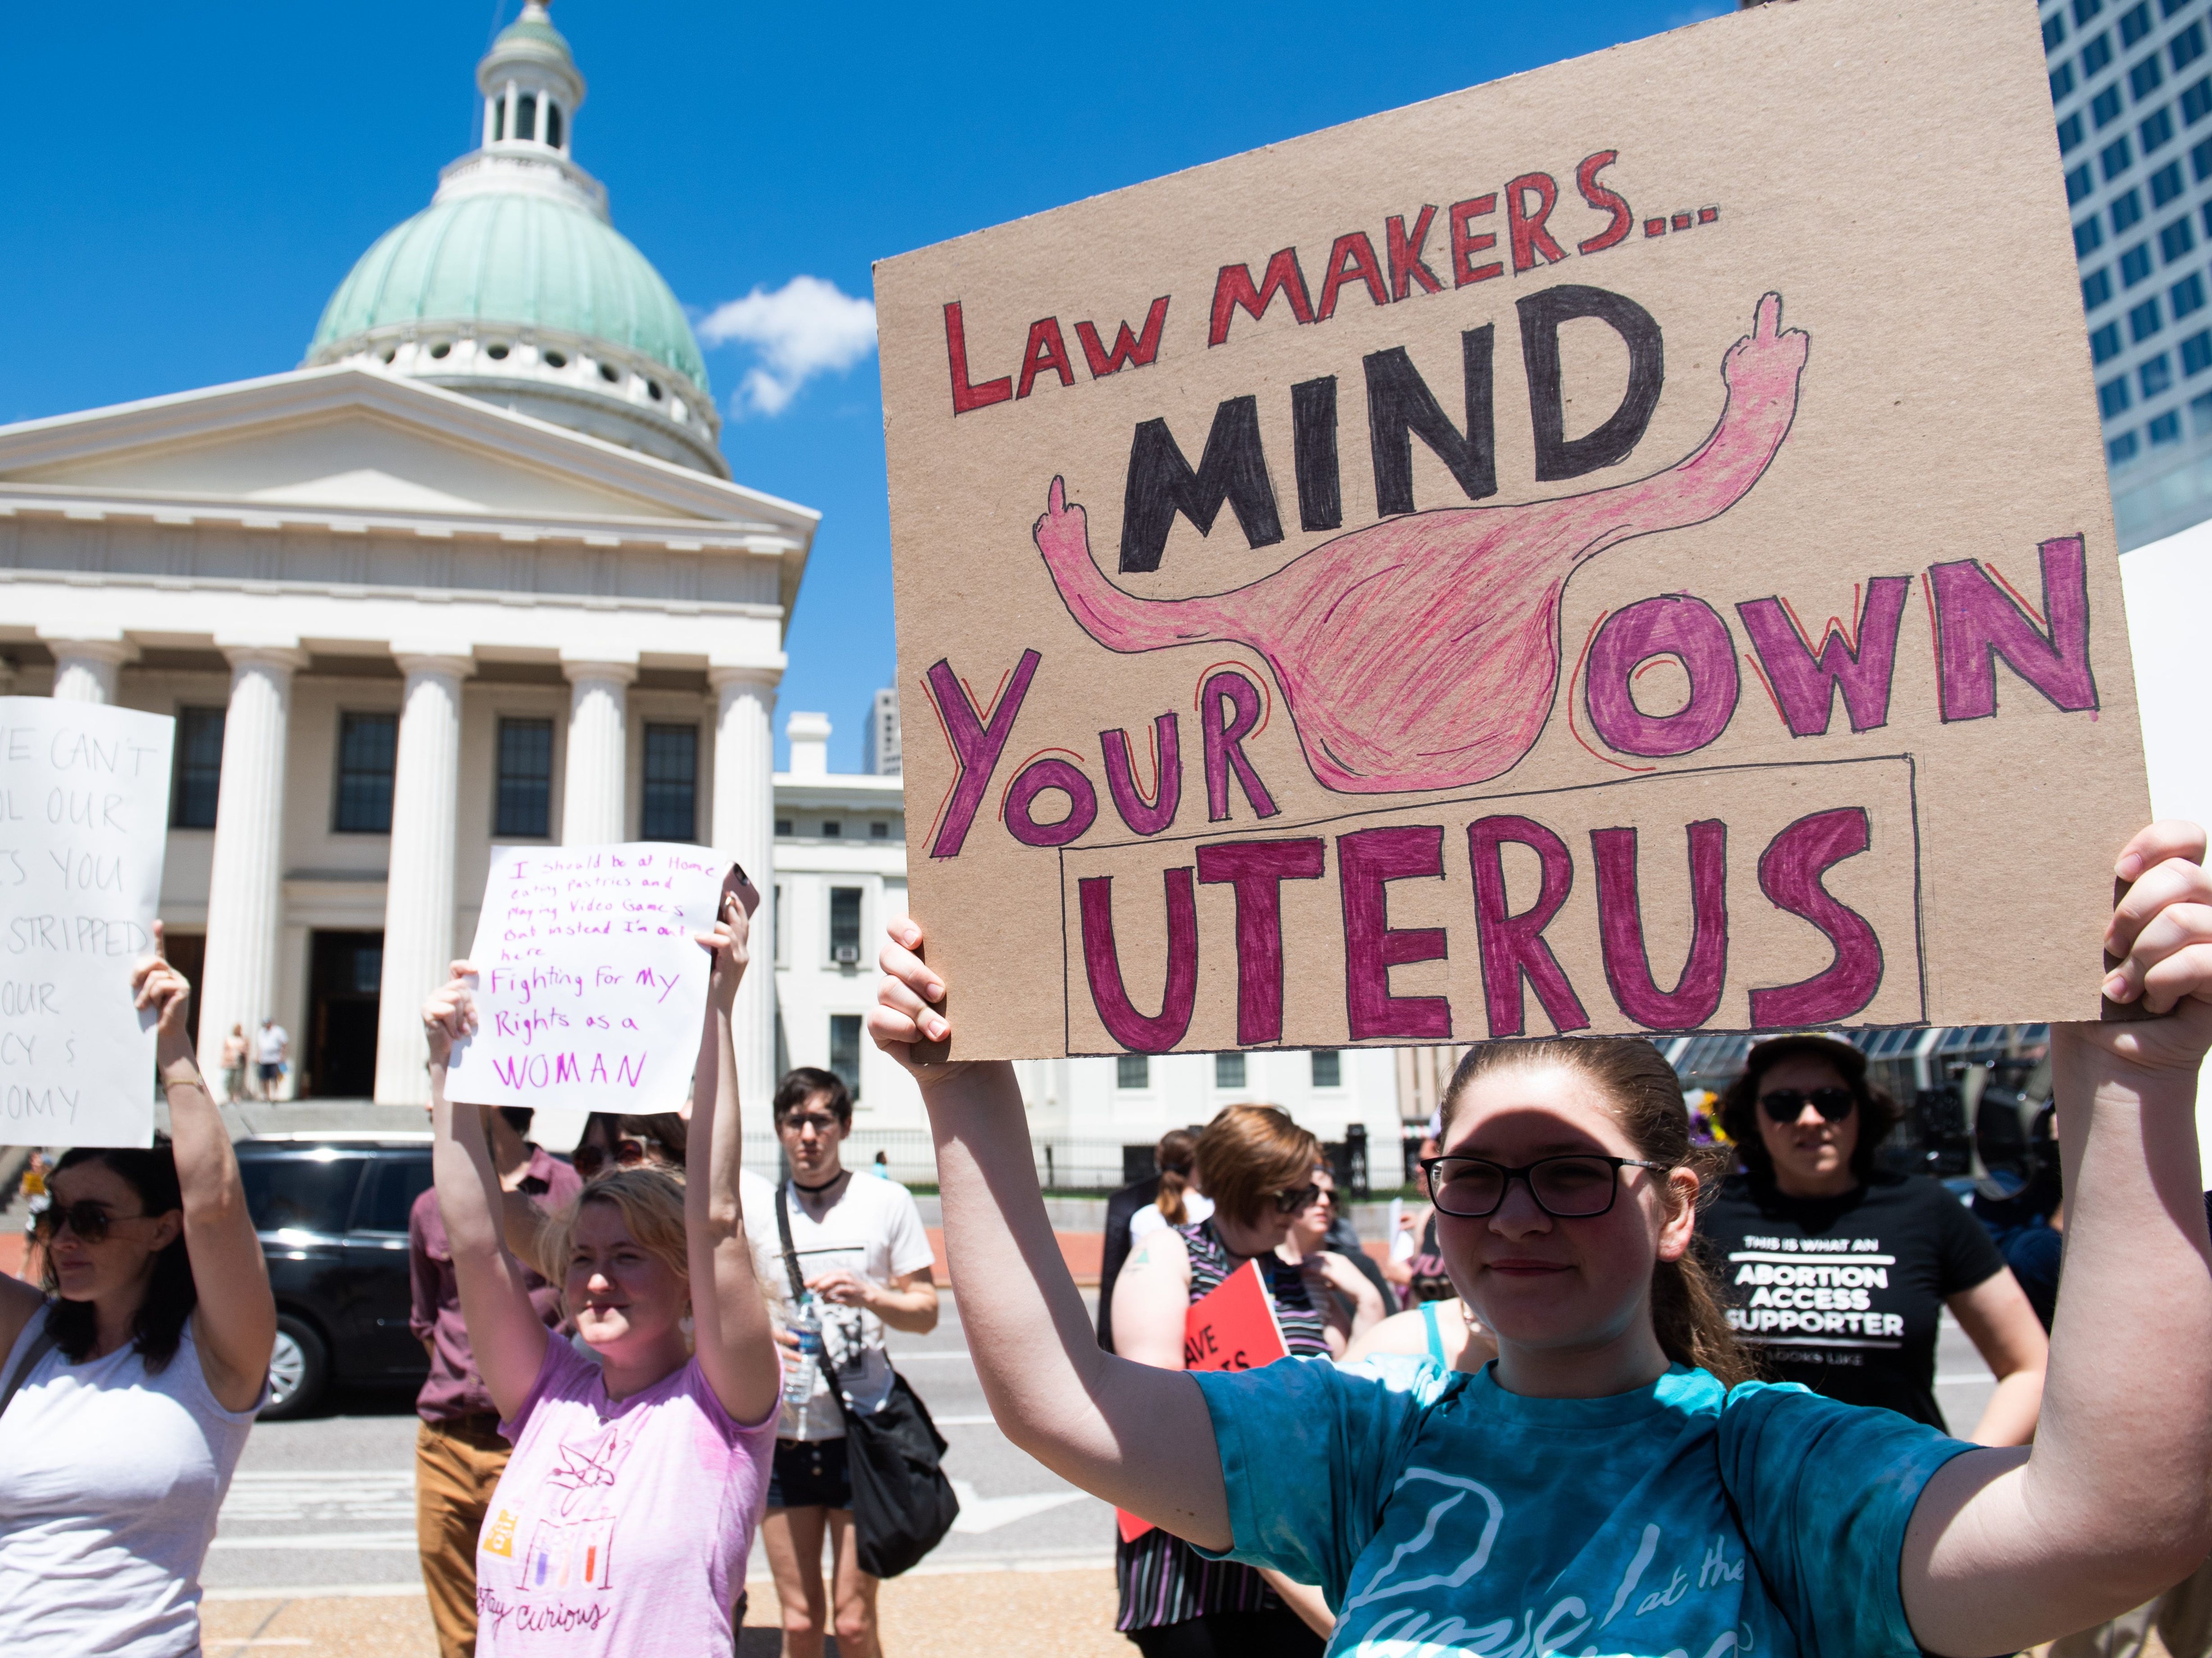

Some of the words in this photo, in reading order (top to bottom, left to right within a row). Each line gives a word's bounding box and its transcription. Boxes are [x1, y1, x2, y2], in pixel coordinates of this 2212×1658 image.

[944, 295, 1170, 417] LAW
[1119, 284, 1664, 575] MIND
[927, 648, 1281, 859] YOUR
[1584, 532, 2100, 758] OWN
[51, 727, 157, 776] CAN'T
[47, 787, 126, 833] OUR
[49, 847, 122, 891] YOU
[510, 861, 528, 879] I
[612, 854, 625, 867] be
[638, 854, 653, 867] at
[642, 877, 672, 890] and
[8, 914, 148, 956] STRIPPED
[549, 921, 610, 936] instead
[624, 919, 647, 932] I'm
[1079, 806, 1884, 1054] UTERUS
[501, 948, 545, 961] here
[492, 966, 583, 1004] Fighting
[496, 1007, 569, 1045] Rights
[587, 1015, 610, 1030] as
[622, 1018, 639, 1031] a
[493, 1051, 647, 1090] WOMAN
[1743, 1236, 1780, 1250] THIS
[1782, 1238, 1798, 1251] IS
[1799, 1239, 1850, 1252] WHAT
[1851, 1239, 1879, 1251] AN
[1734, 1264, 1888, 1289] ABORTION
[1749, 1286, 1871, 1310] ACCESS
[1725, 1309, 1904, 1336] SUPPORTER
[1635, 1565, 1689, 1616] at
[1698, 1534, 1745, 1588] the
